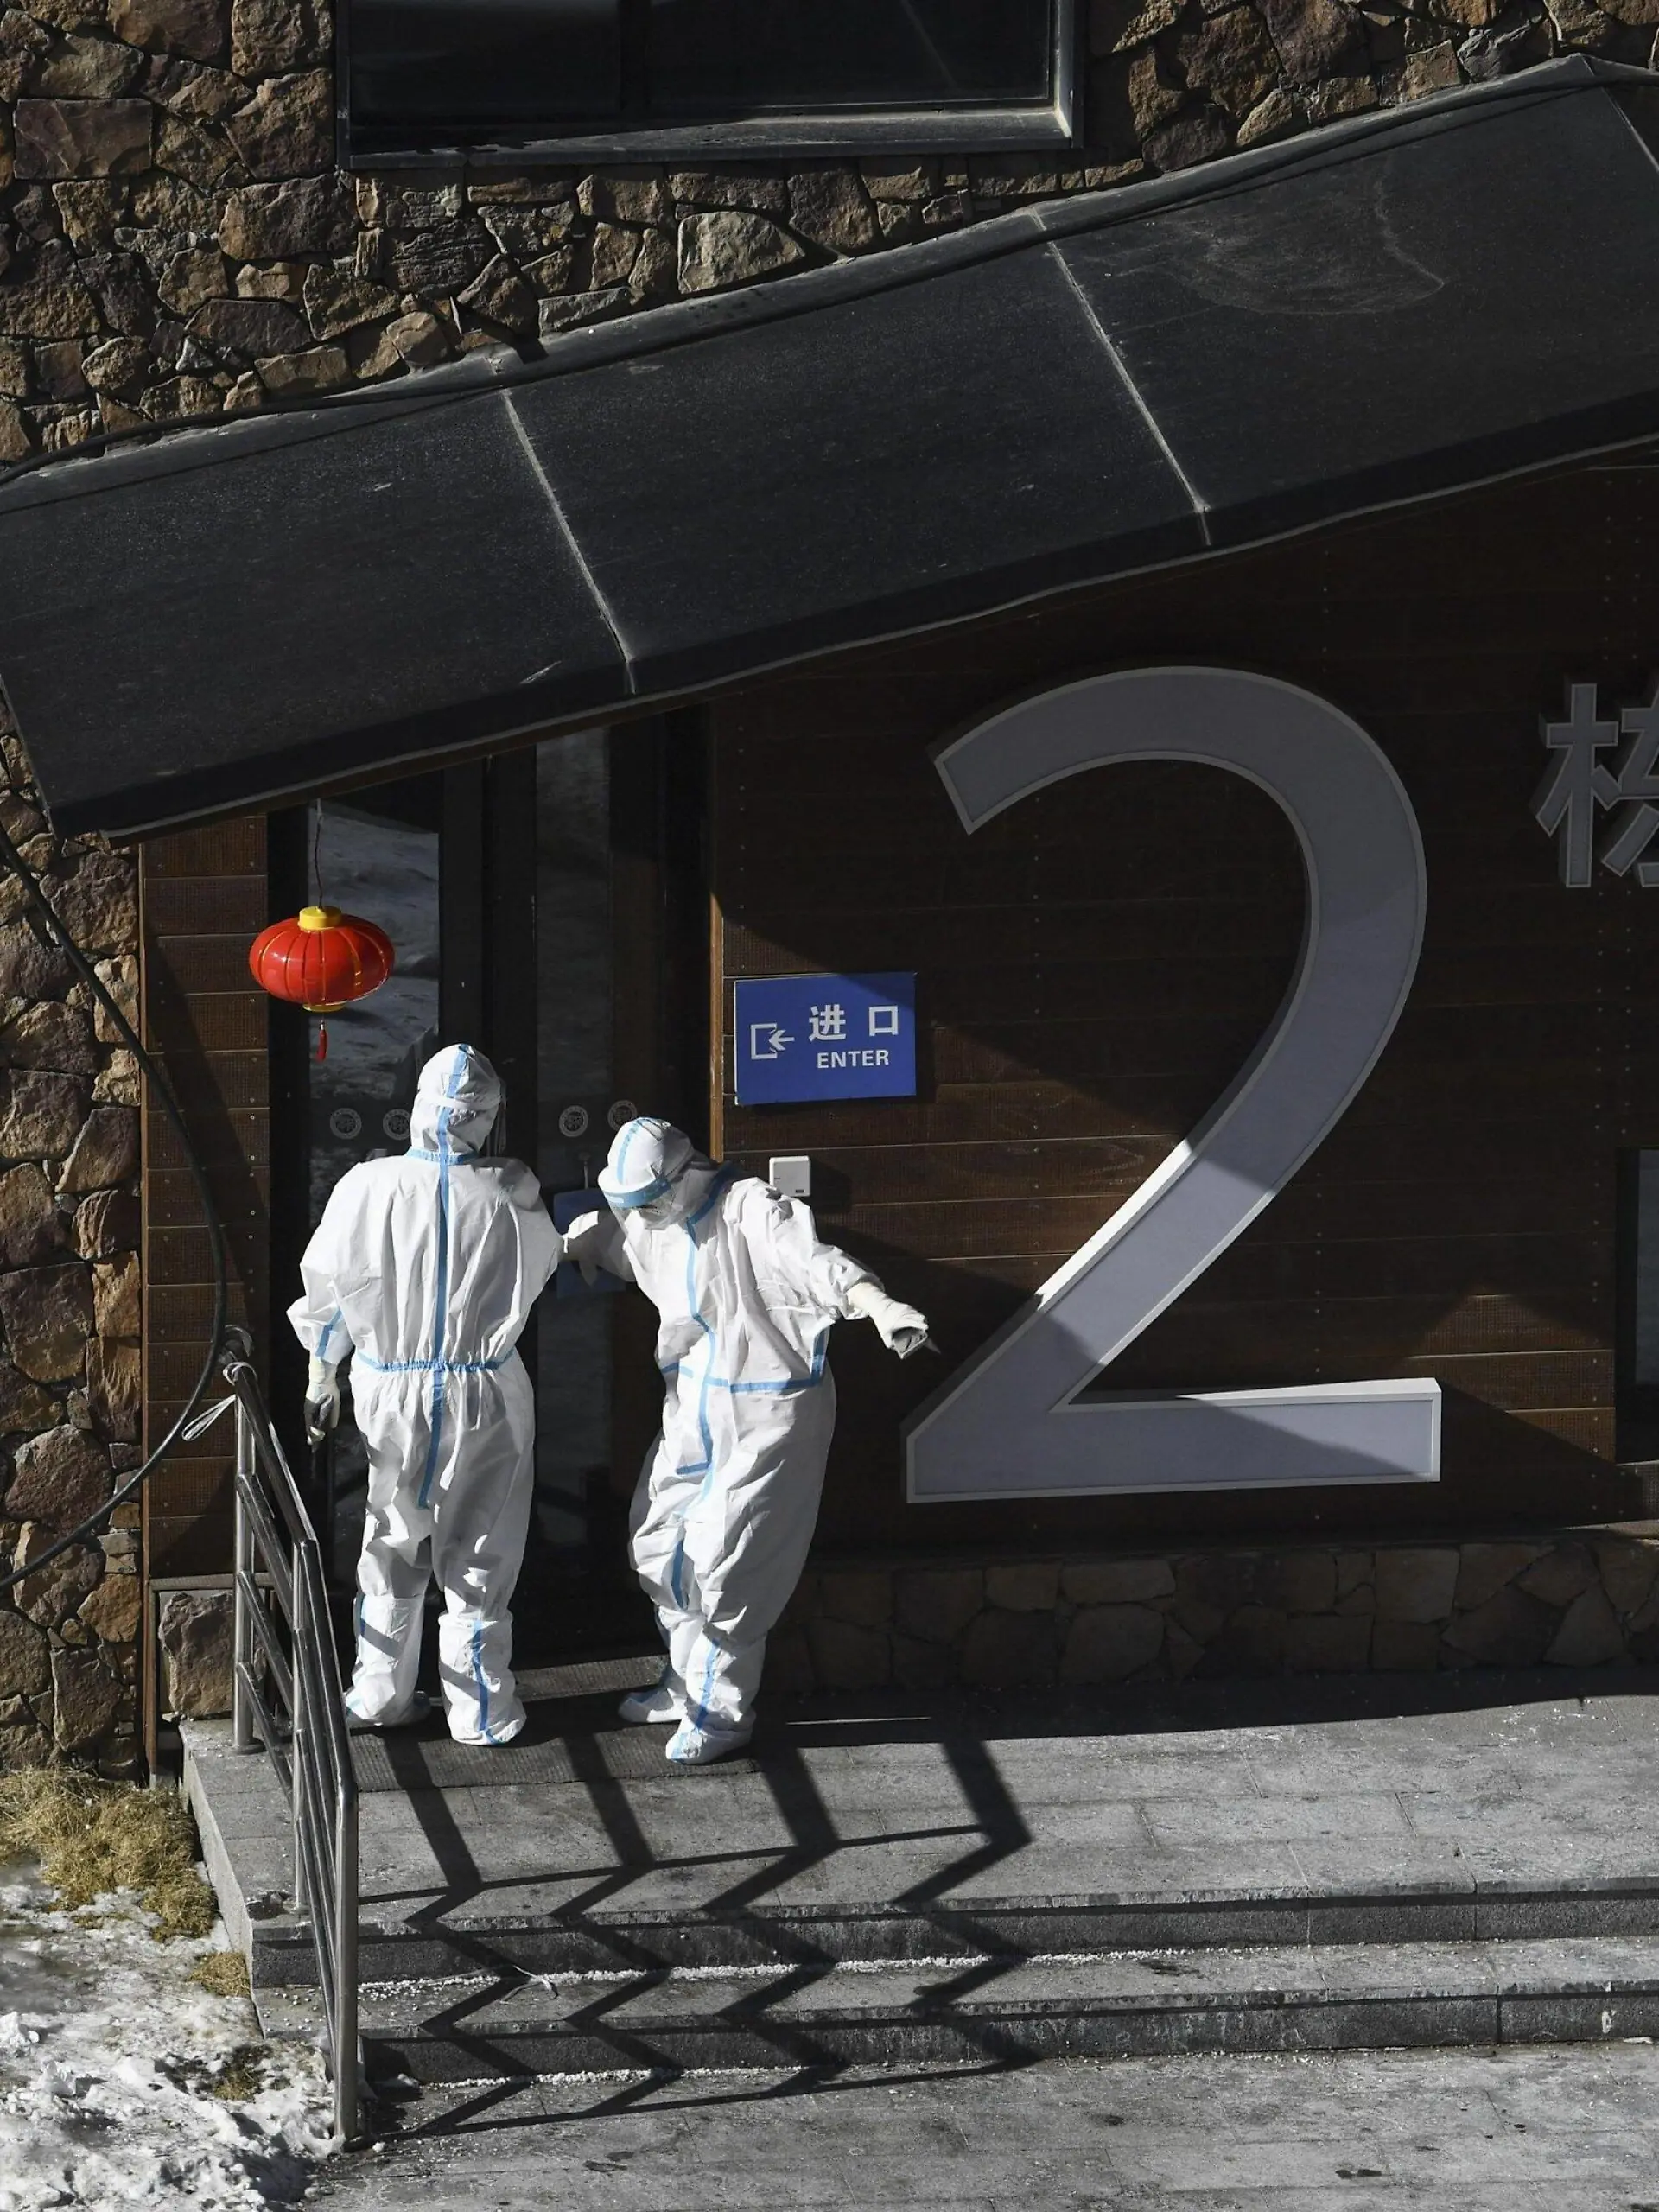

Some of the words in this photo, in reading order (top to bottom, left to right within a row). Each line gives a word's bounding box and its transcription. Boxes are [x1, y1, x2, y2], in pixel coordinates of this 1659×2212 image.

[809, 1003, 899, 1042] 进口
[817, 1049, 889, 1069] ENTER
[905, 665, 1441, 1503] 2
